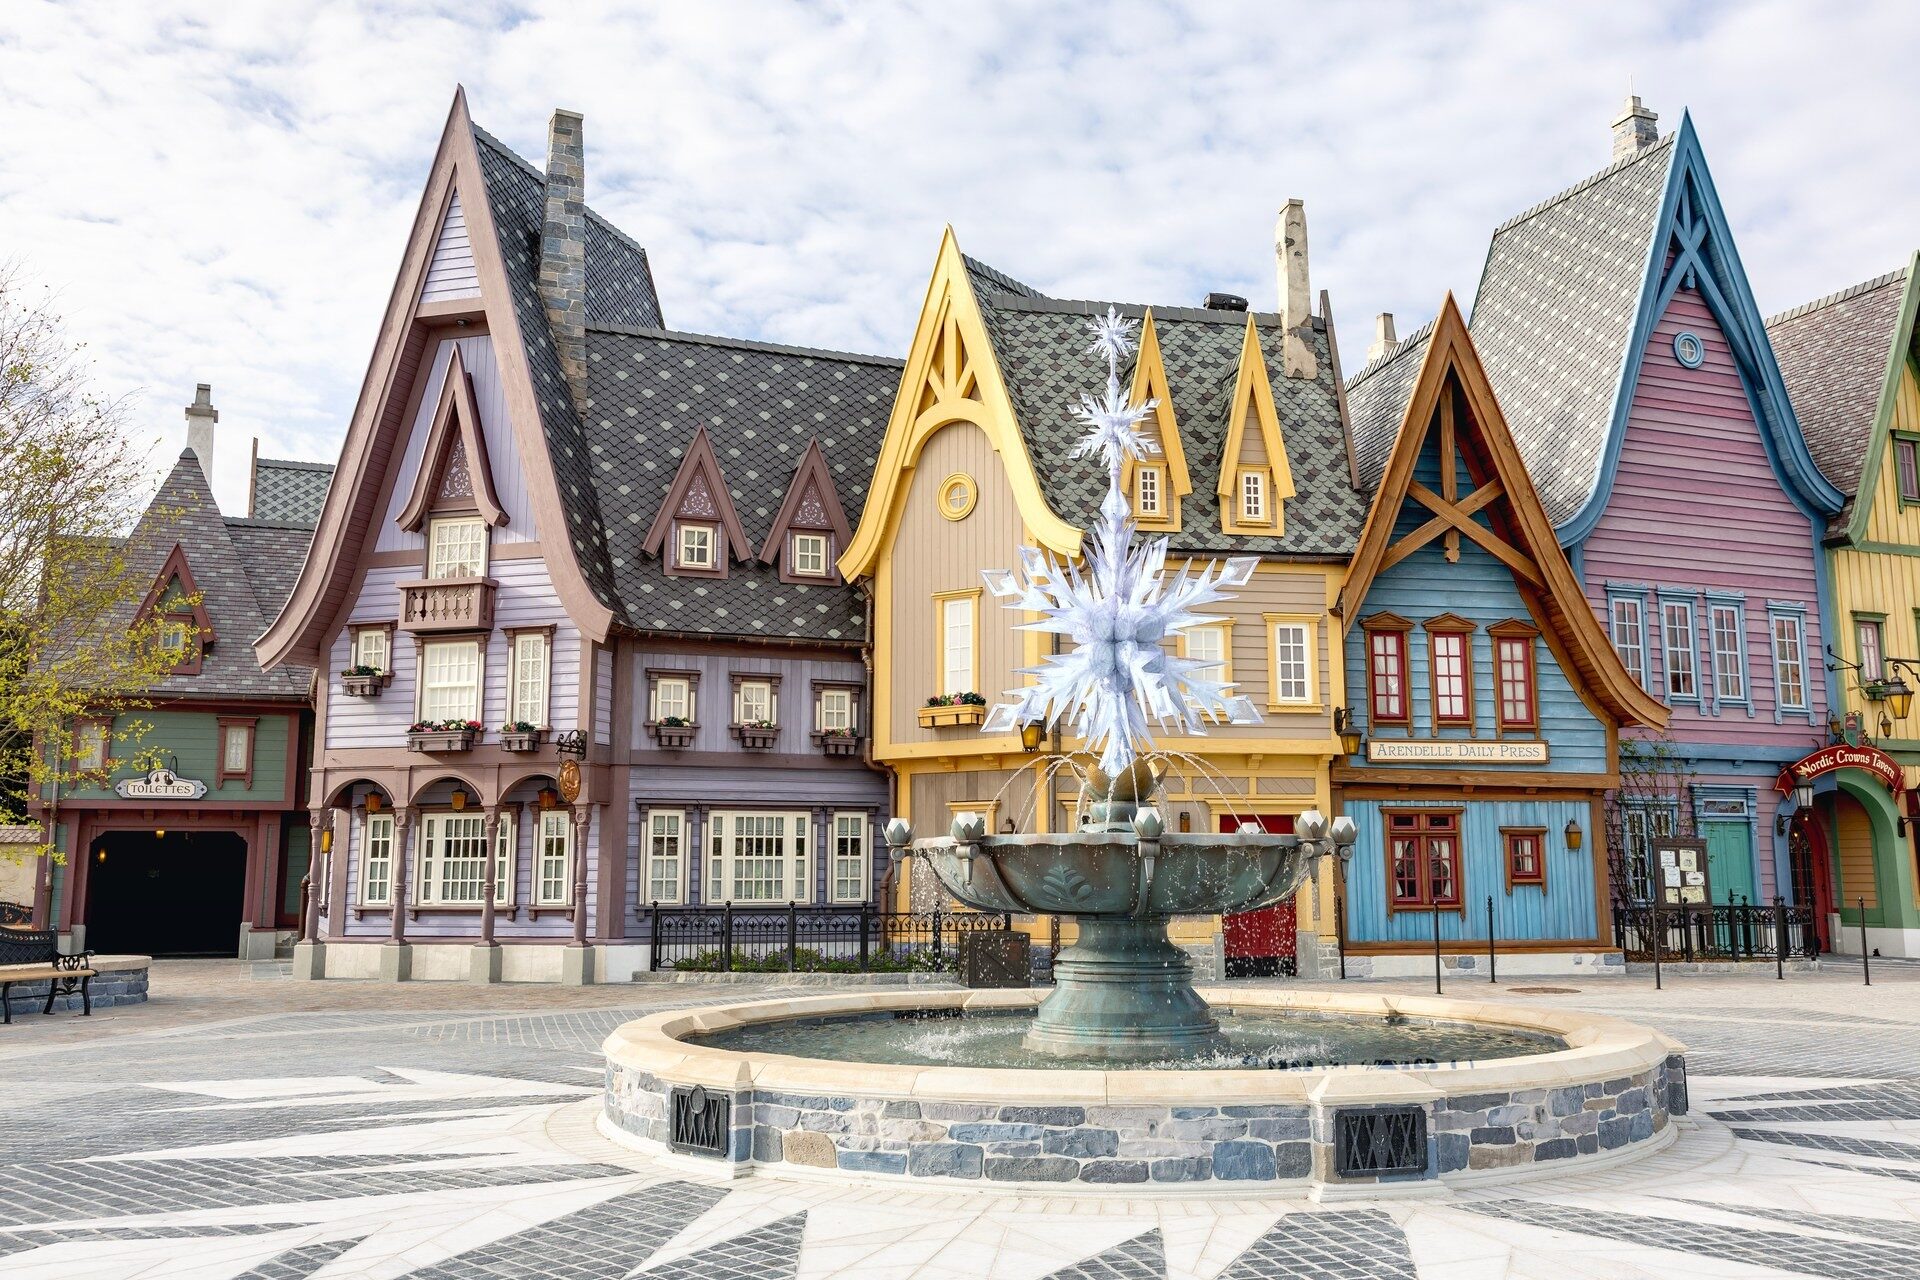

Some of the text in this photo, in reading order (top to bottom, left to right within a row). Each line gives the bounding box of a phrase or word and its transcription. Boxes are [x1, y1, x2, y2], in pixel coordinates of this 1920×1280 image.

[1377, 744, 1540, 757] ARENDELLE DAILY PRESS
[1797, 750, 1895, 779] Nordic Crowns Tavern
[131, 784, 191, 794] TOILETTES
